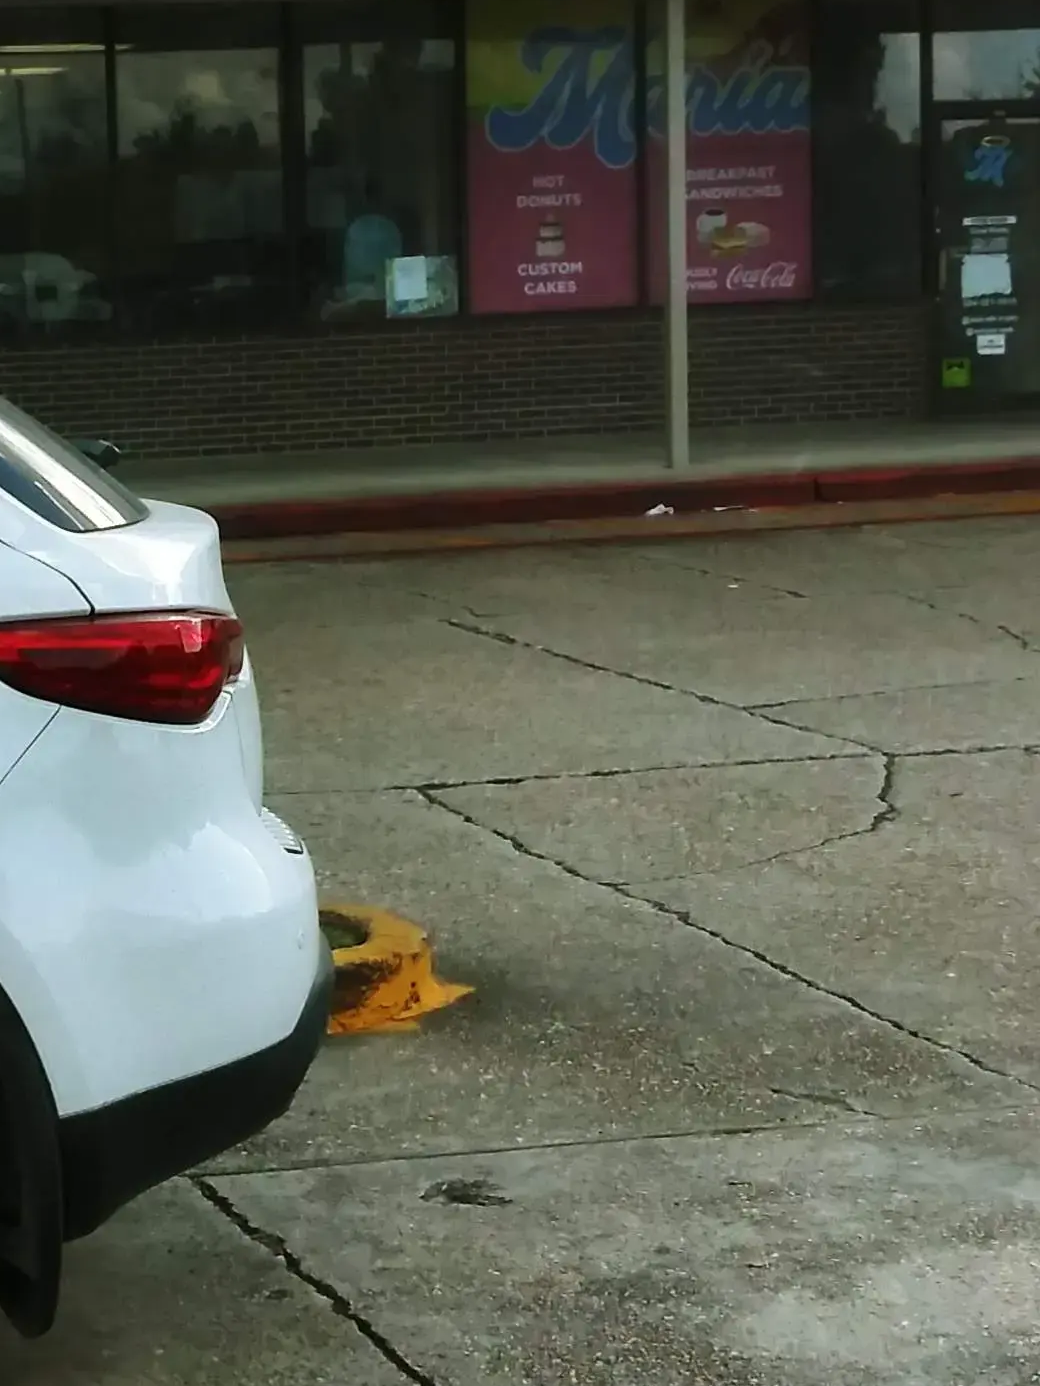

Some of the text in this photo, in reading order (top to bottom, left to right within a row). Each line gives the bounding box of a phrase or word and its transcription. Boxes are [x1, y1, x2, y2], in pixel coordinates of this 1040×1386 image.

[532, 174, 565, 188] HOT
[516, 193, 582, 209] DONUTS
[517, 261, 583, 276] CUSTOM
[524, 280, 577, 295] CAKES
